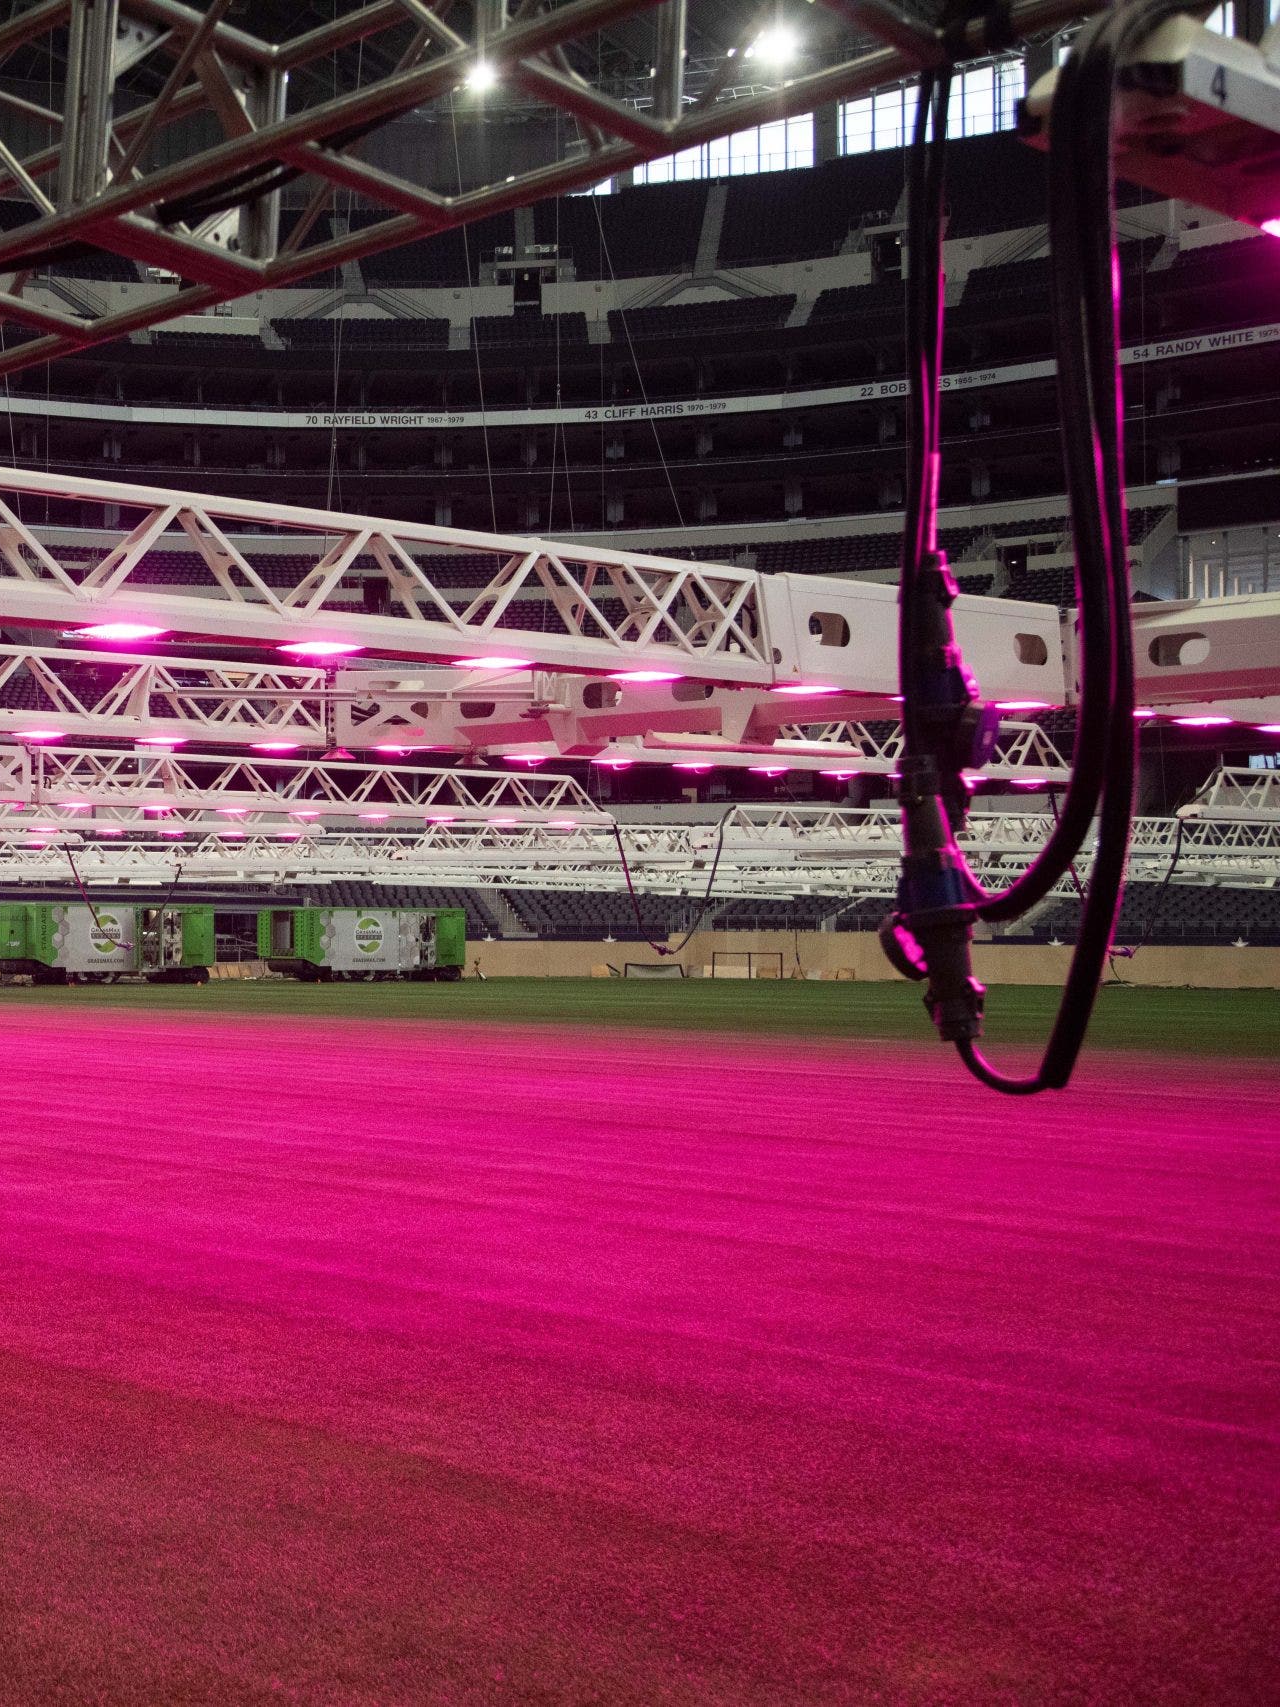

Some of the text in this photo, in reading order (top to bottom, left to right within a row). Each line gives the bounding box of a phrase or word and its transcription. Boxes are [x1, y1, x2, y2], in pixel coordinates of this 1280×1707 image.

[1209, 64, 1227, 105] 4
[1133, 348, 1150, 360] 54
[1156, 339, 1202, 356] RANDY
[1209, 331, 1254, 348] WHITE
[860, 387, 874, 397] 22
[880, 383, 907, 395] BOB
[305, 415, 318, 425] 70
[323, 415, 376, 425] RAYFIELD
[380, 415, 424, 425] WRIGHT
[585, 410, 598, 420] 43
[604, 408, 636, 419] CLIFF
[640, 404, 684, 417] HARRIS
